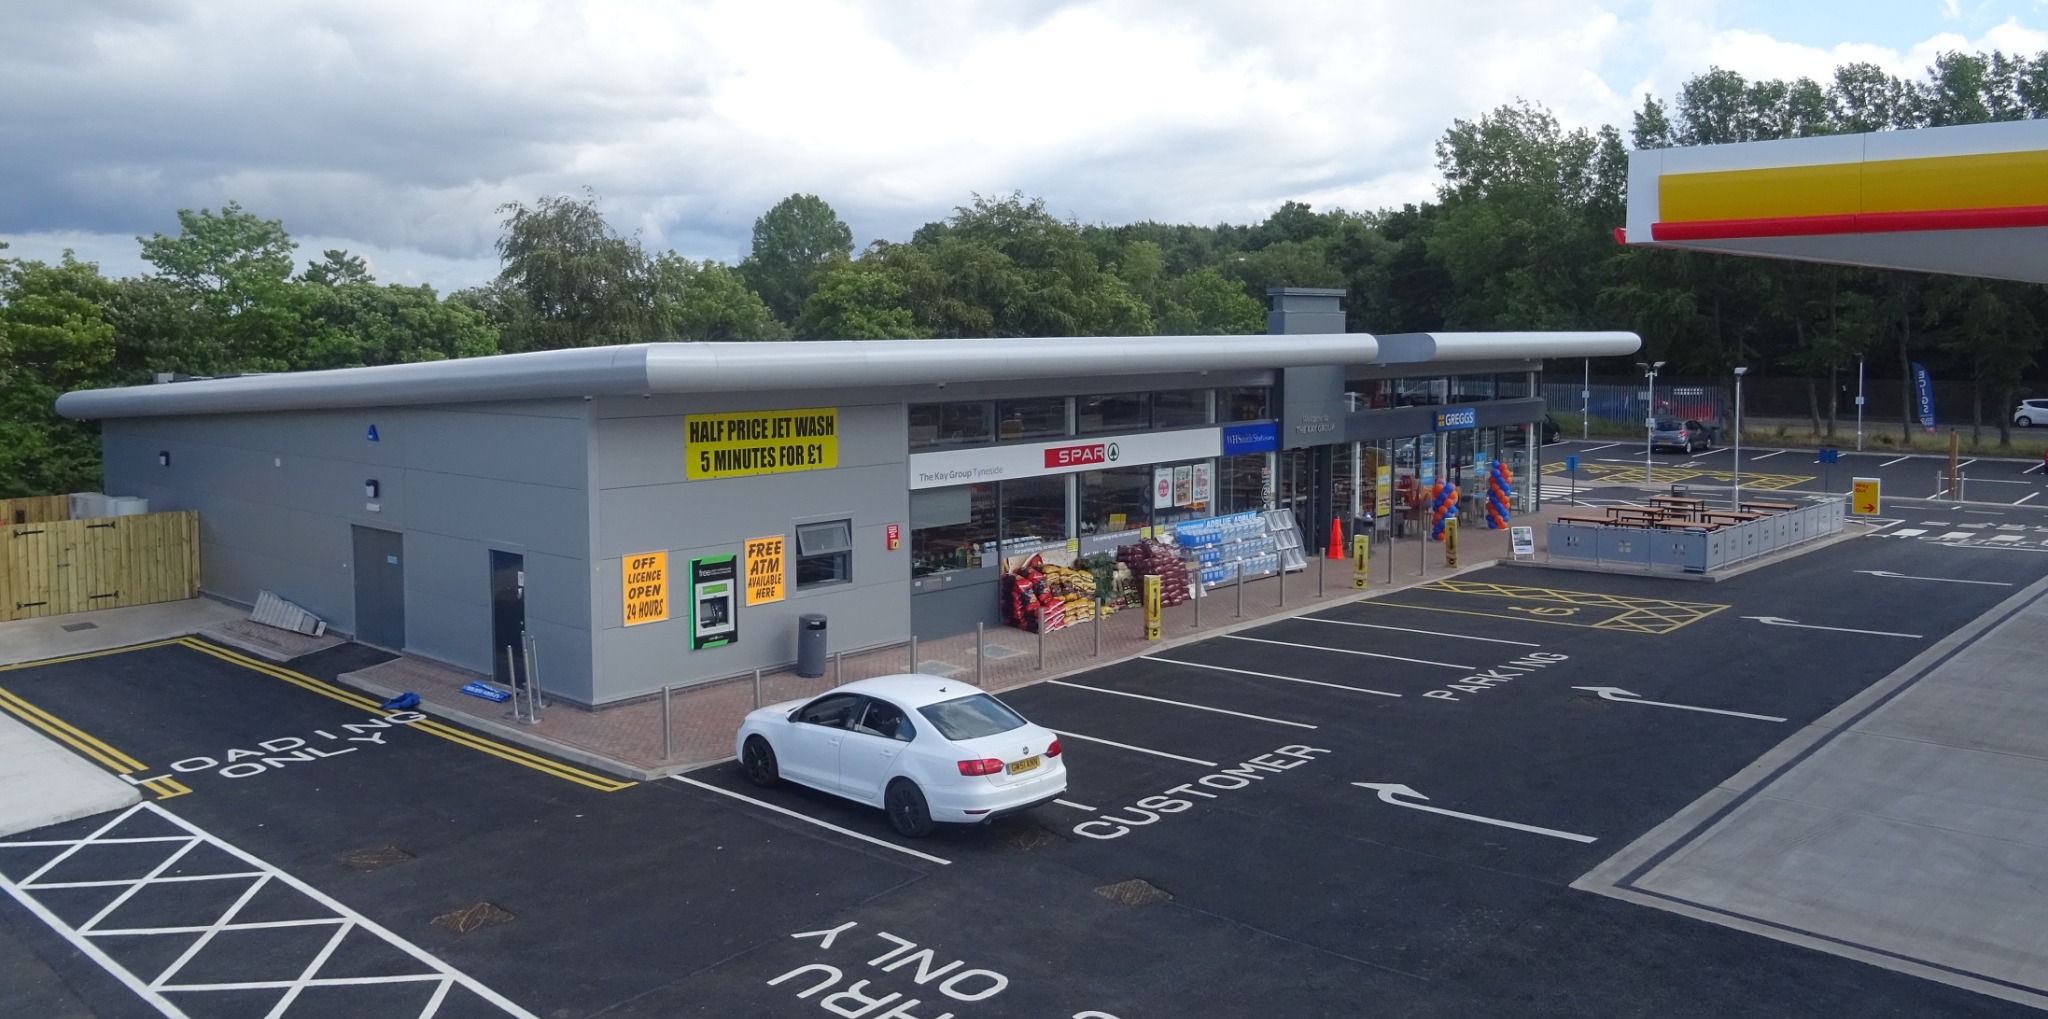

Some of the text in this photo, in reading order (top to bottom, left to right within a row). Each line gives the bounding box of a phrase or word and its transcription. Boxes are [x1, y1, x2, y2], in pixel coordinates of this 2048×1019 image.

[1446, 412, 1474, 425] GREGGS
[689, 415, 834, 443] HALF PRICE JET WASH
[1296, 425, 1307, 433] THE
[1318, 423, 1335, 432] GROUP
[1227, 433, 1252, 444] WHSmith
[701, 444, 823, 472] 5 MINUTES FOR £1
[1058, 446, 1104, 463] SPAR
[919, 466, 1003, 482] The Kay Group Tyneside
[1206, 517, 1232, 528] ADBLUE
[748, 540, 782, 558] FREE
[632, 557, 656, 570] OFF
[750, 558, 780, 576] ATM
[627, 569, 661, 585] LICENCE
[699, 569, 711, 577] free
[748, 573, 782, 589] AVAILABLE
[628, 584, 661, 600] OPEN
[756, 586, 775, 599] HERE
[626, 599, 664, 620] 24 HOURS
[1422, 651, 1569, 702] PARKING
[119, 709, 428, 786] LOADING
[218, 731, 388, 779] ONLY
[1072, 743, 1332, 840] CUSTOMER
[791, 921, 1009, 1001] ONLY
[766, 963, 955, 1019] HRU
